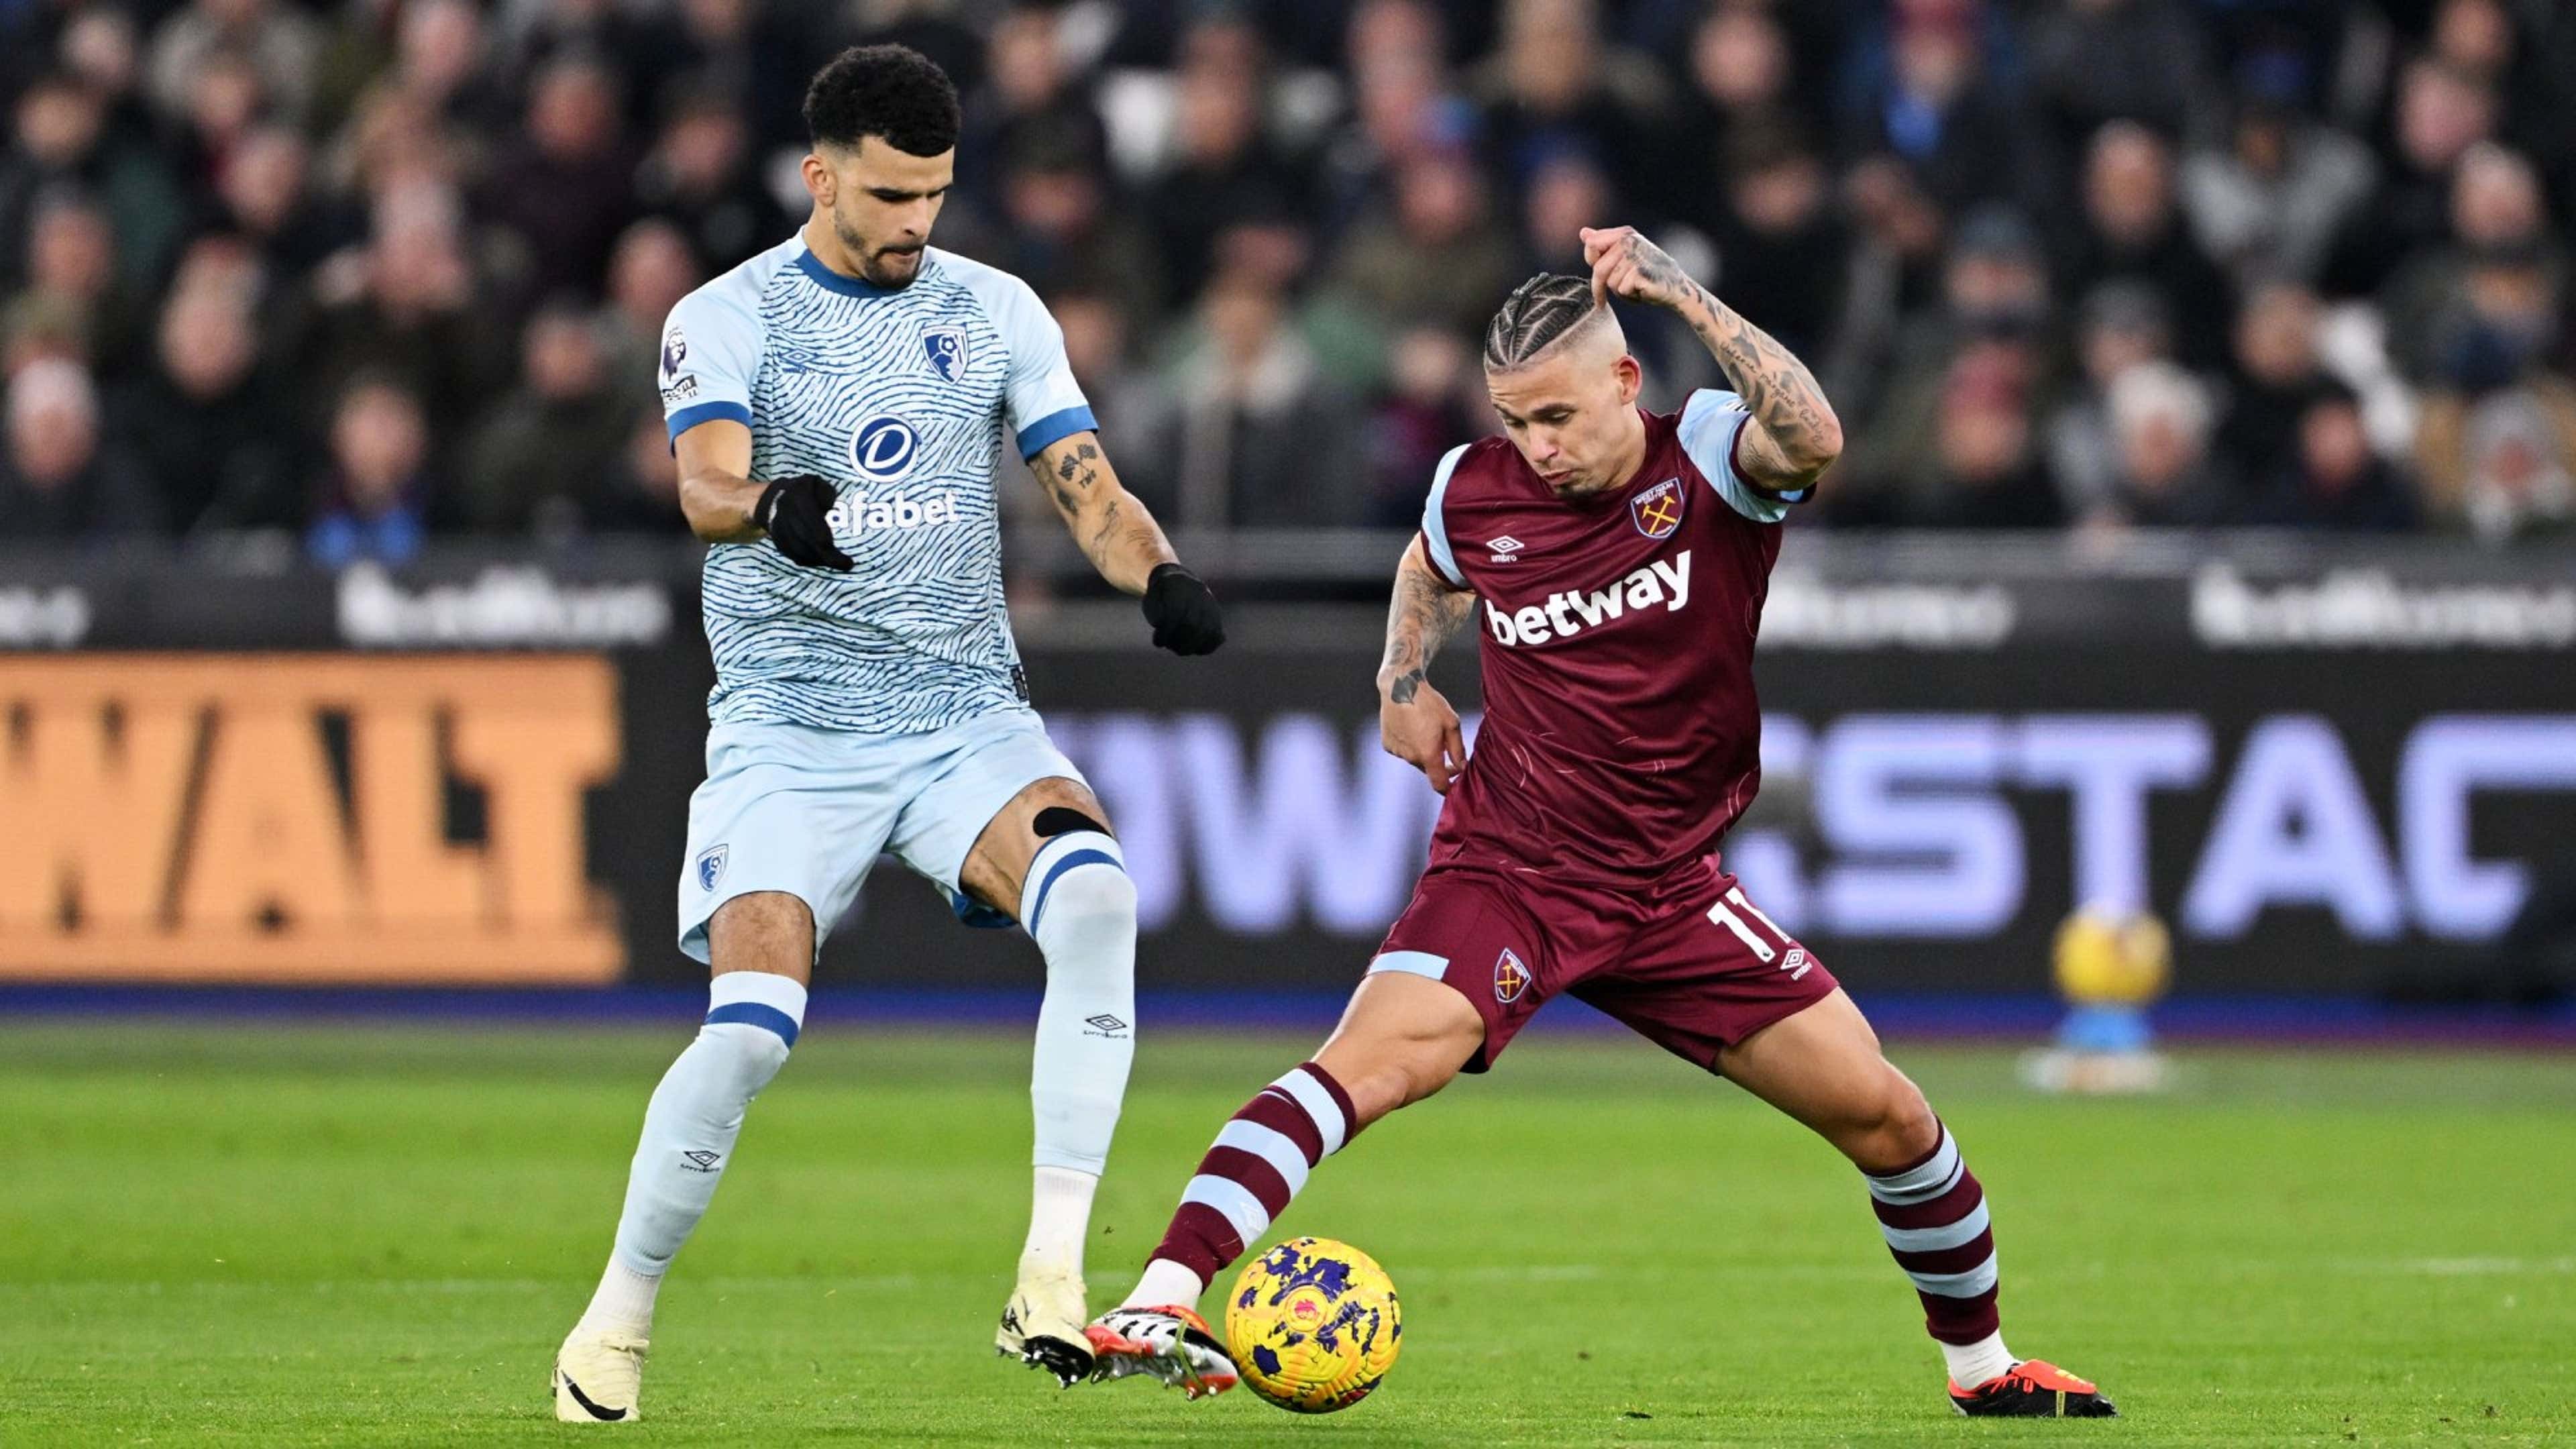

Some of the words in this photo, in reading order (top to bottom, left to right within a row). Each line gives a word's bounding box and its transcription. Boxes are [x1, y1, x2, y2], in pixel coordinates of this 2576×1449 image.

[824, 488, 959, 537] afabet
[1491, 553, 1517, 563] umbro
[1485, 549, 1691, 647] betway
[1706, 887, 1792, 963] 11
